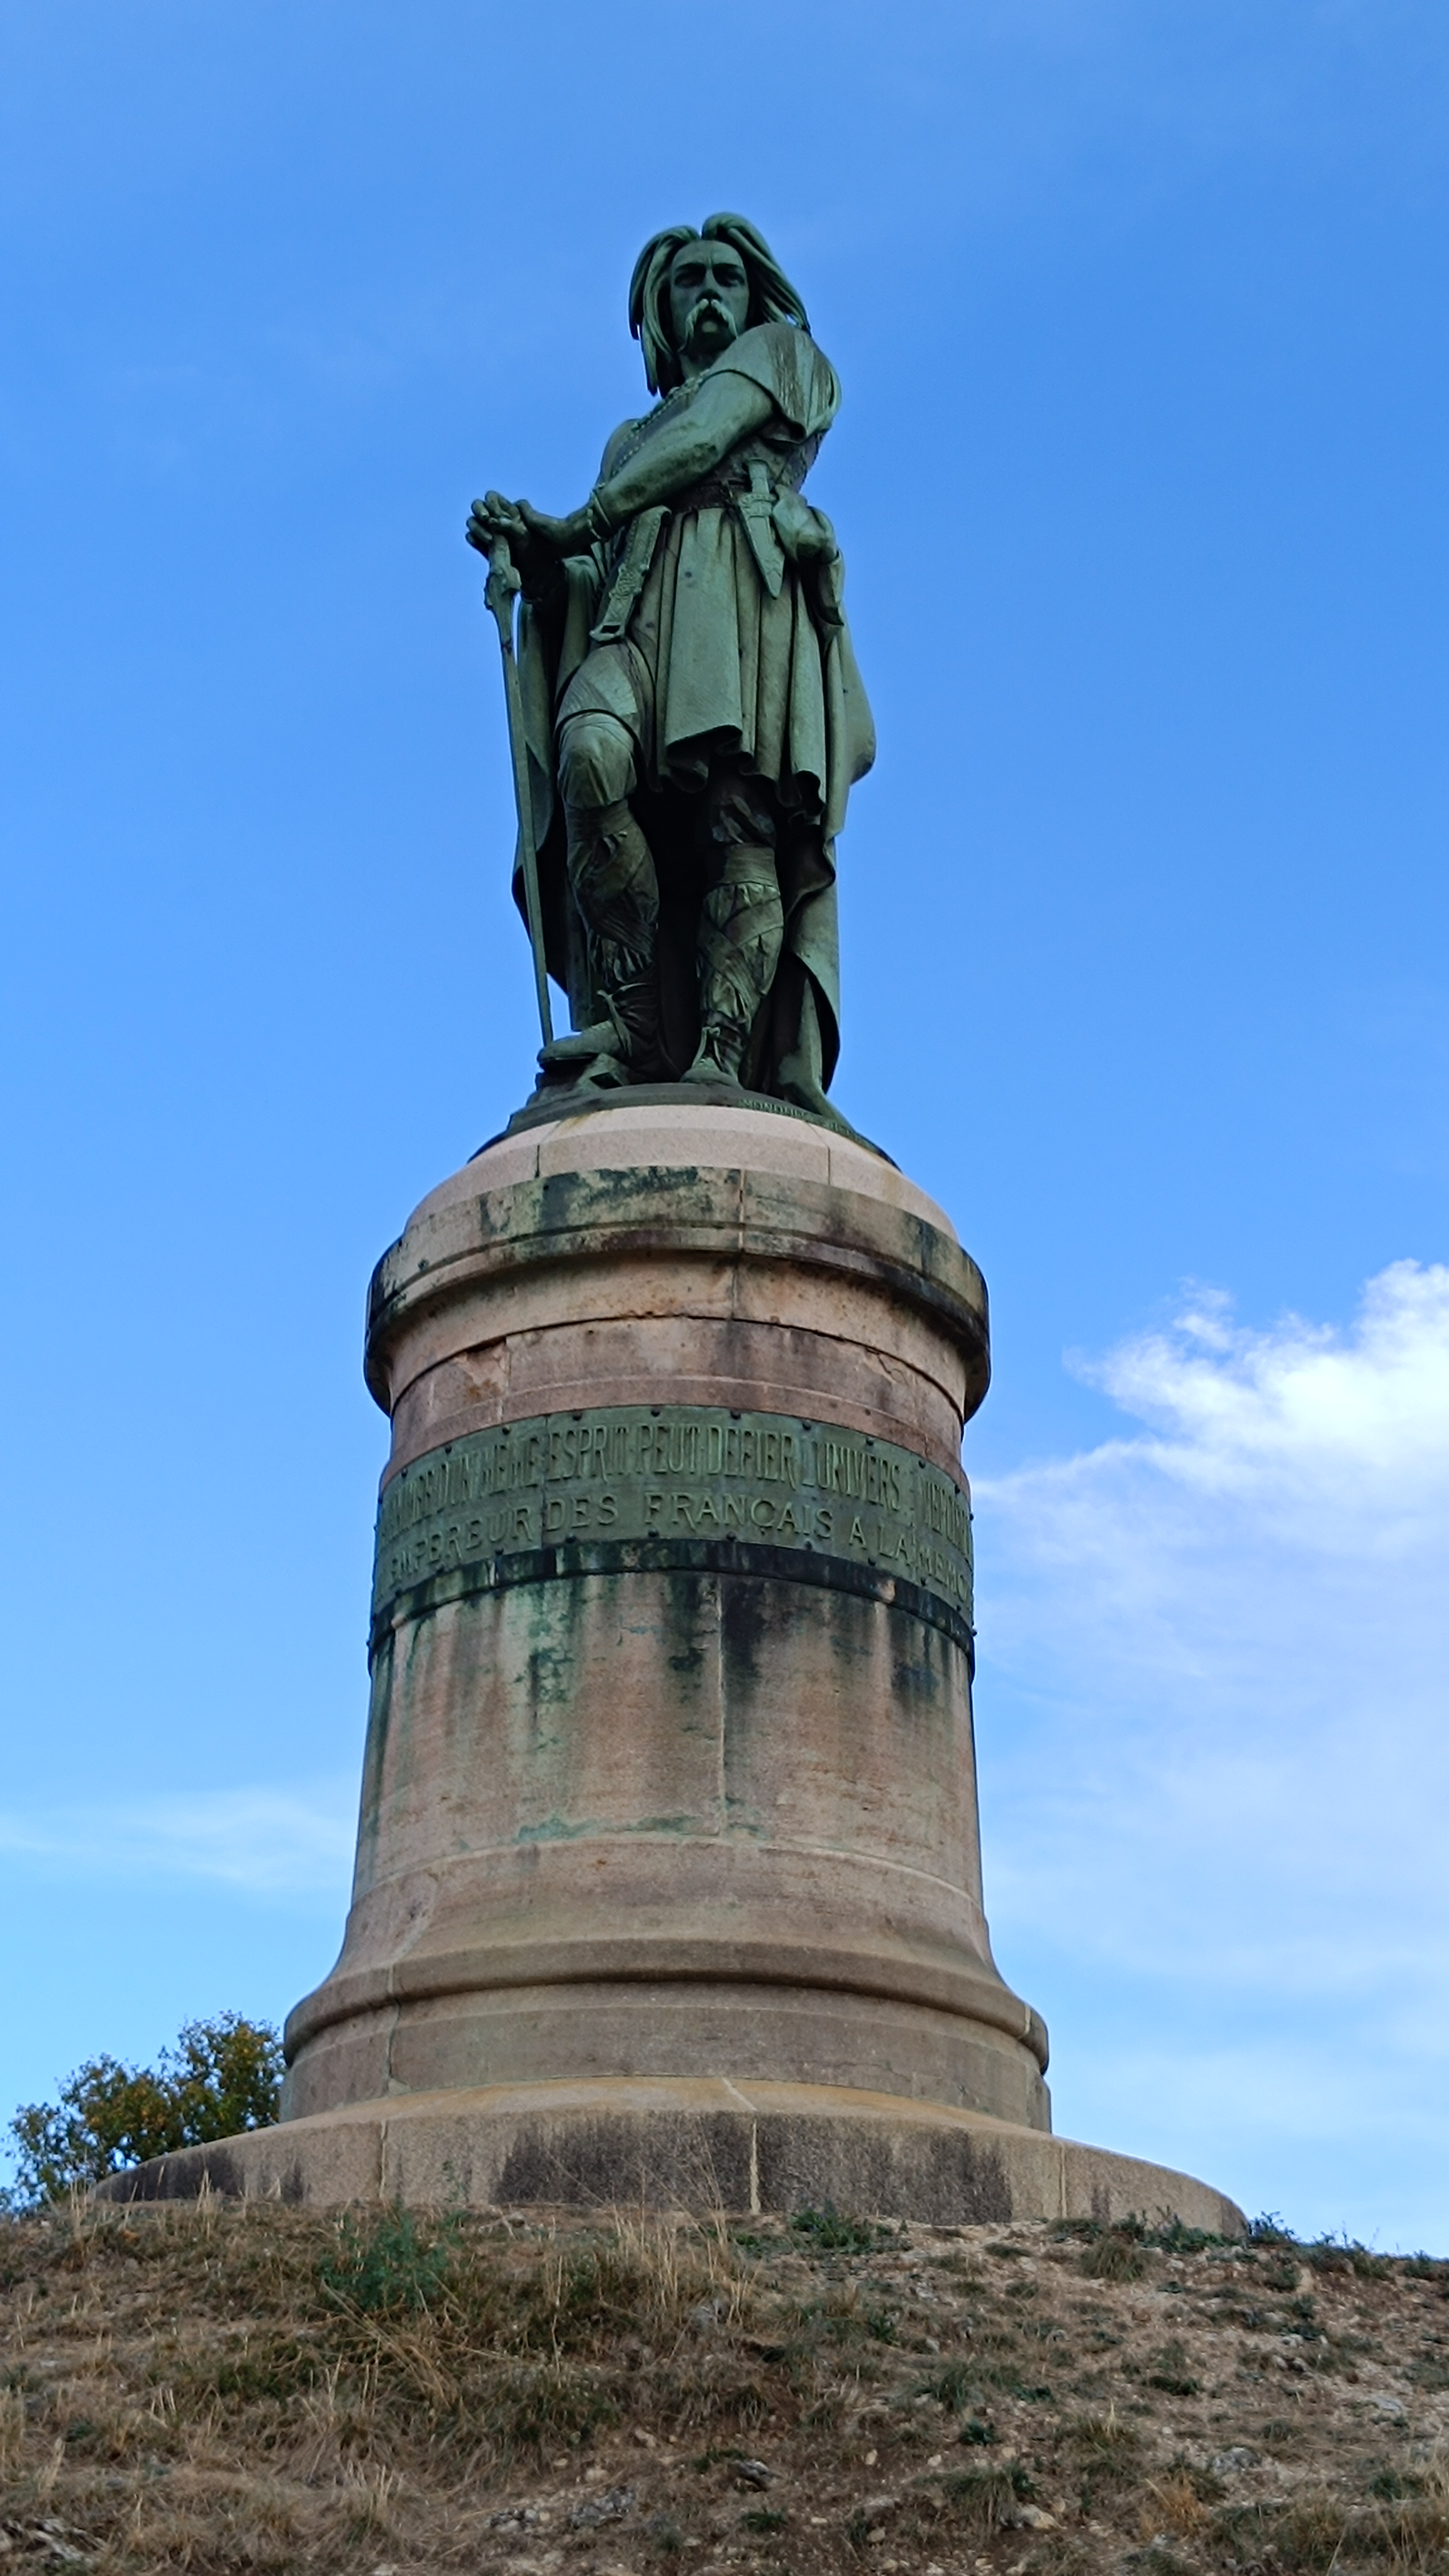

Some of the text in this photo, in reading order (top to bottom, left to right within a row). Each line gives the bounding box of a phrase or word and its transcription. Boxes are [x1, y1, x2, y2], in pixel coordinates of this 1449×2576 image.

[546, 1424, 630, 1484] ESPRIT
[636, 1421, 700, 1475] PEUT
[707, 1424, 796, 1491] DEFIER
[546, 1492, 619, 1532] DES
[645, 1489, 833, 1539] FRANÇAIS
[877, 1523, 911, 1567] LA
